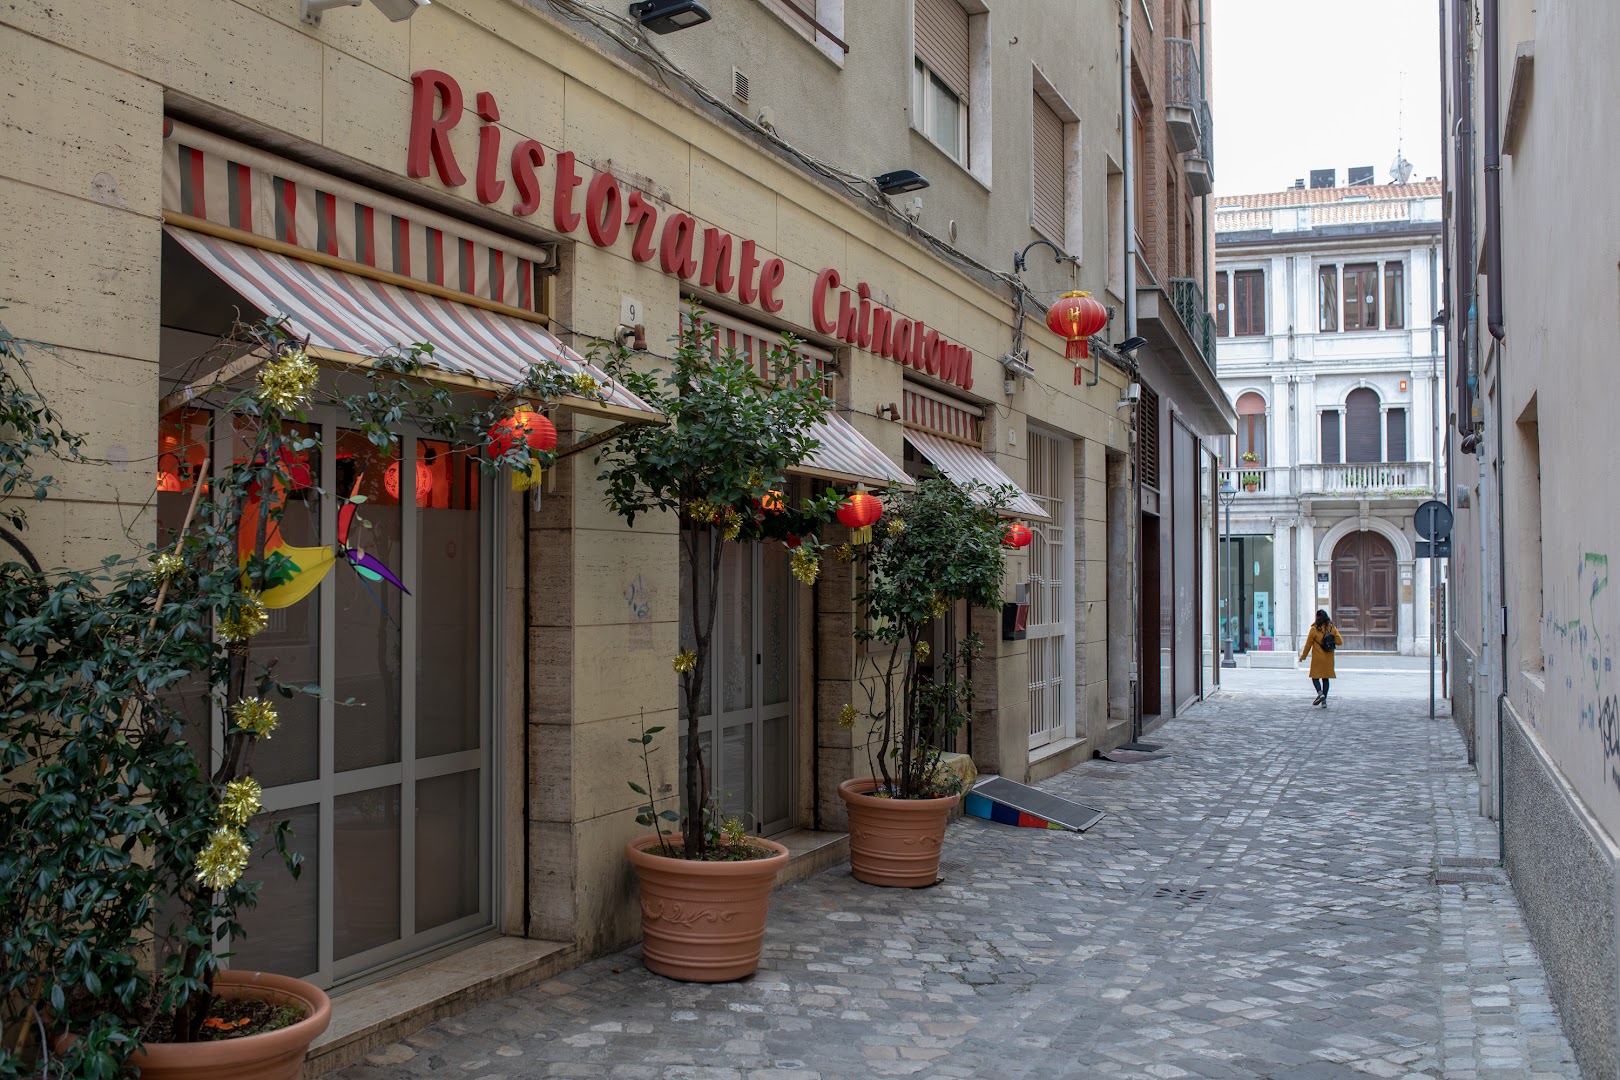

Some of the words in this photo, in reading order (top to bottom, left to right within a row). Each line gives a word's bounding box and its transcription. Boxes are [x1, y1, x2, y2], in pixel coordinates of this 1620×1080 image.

[407, 69, 785, 313] Ristorante
[812, 268, 974, 391] Chinatown
[629, 304, 636, 322] 9
